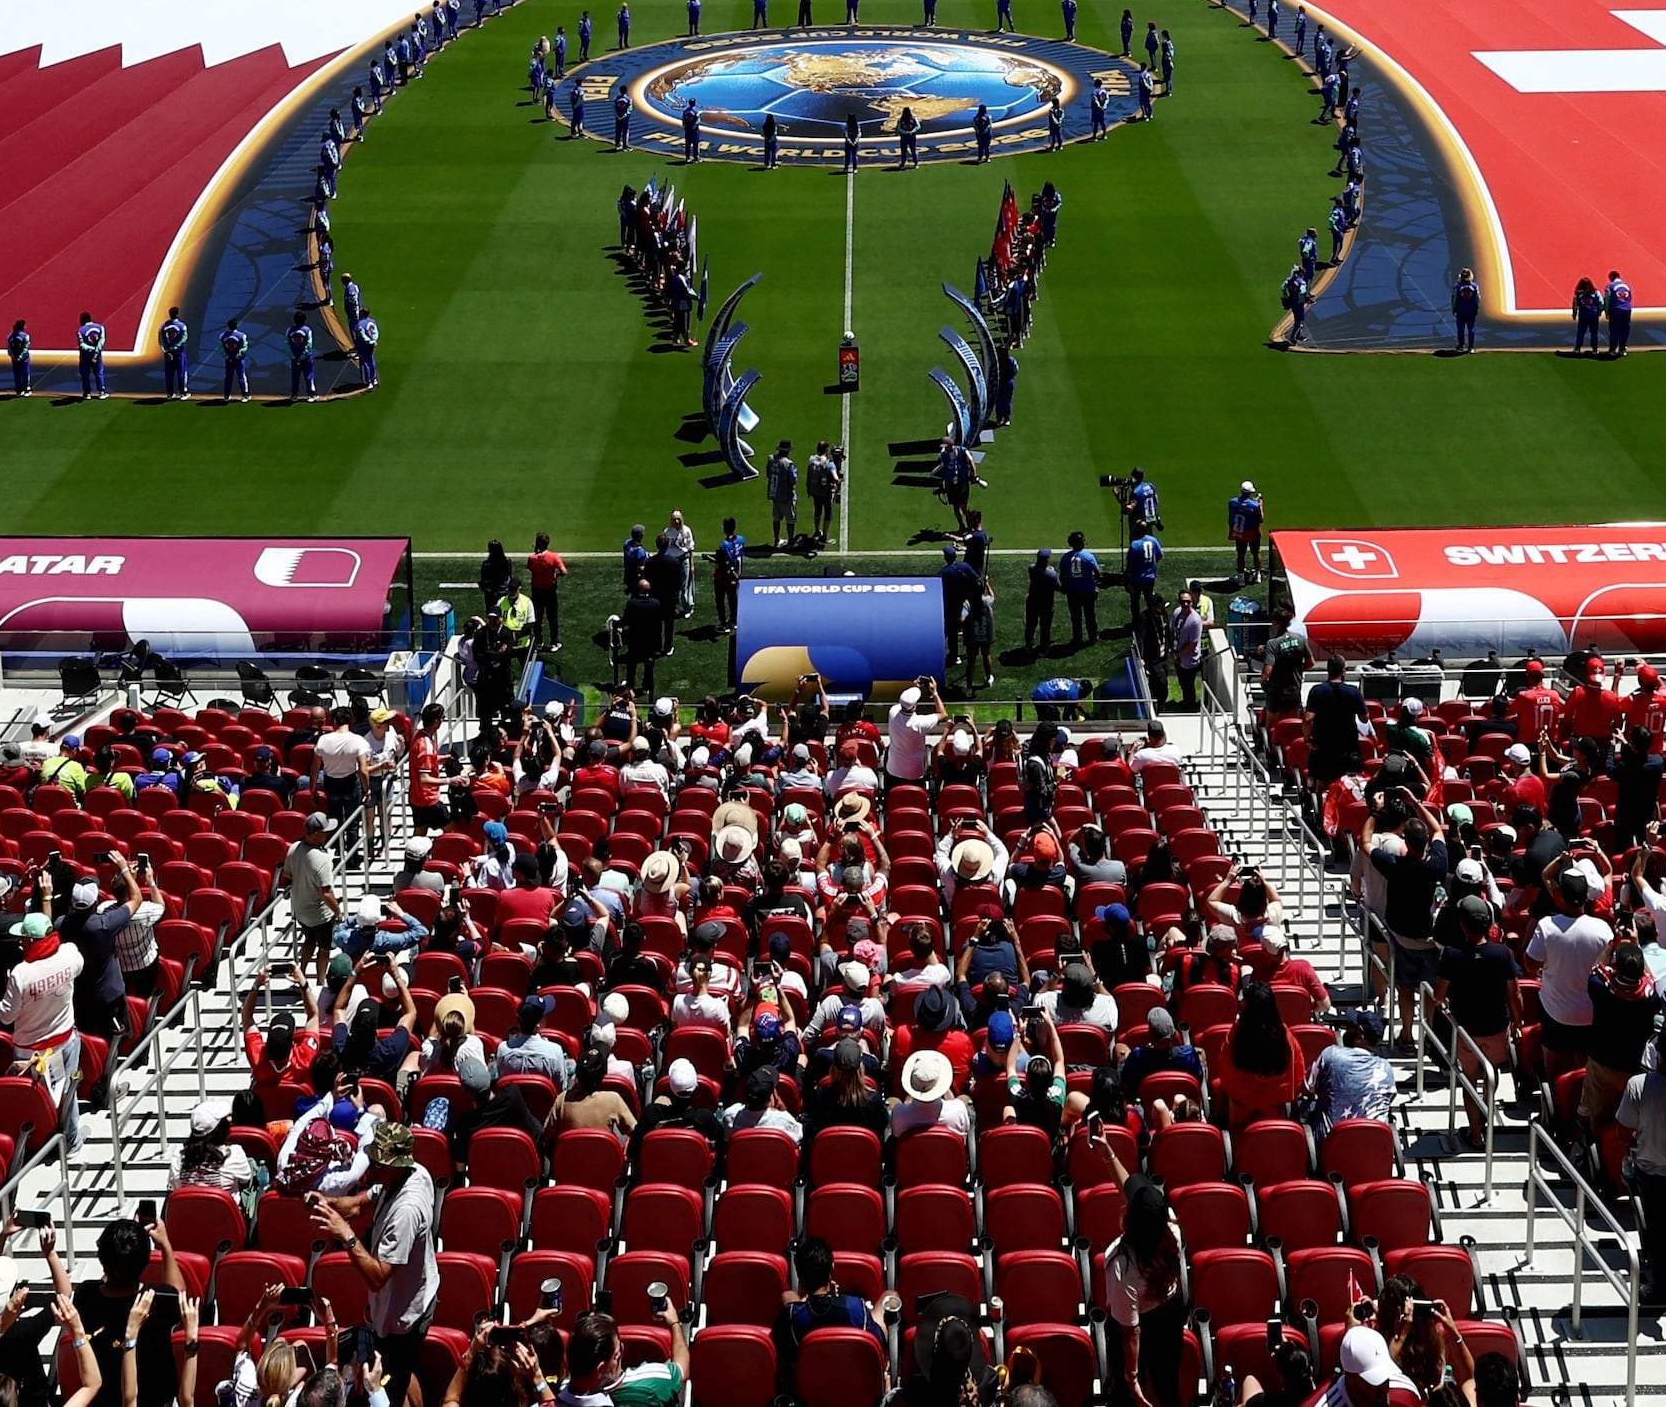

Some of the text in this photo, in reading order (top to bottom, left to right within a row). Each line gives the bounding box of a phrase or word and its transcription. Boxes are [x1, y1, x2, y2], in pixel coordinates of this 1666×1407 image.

[581, 74, 619, 102] FIFA
[754, 584, 926, 595] FIFA WORLD CUP 2026
[28, 966, 72, 1002] 49ERS
